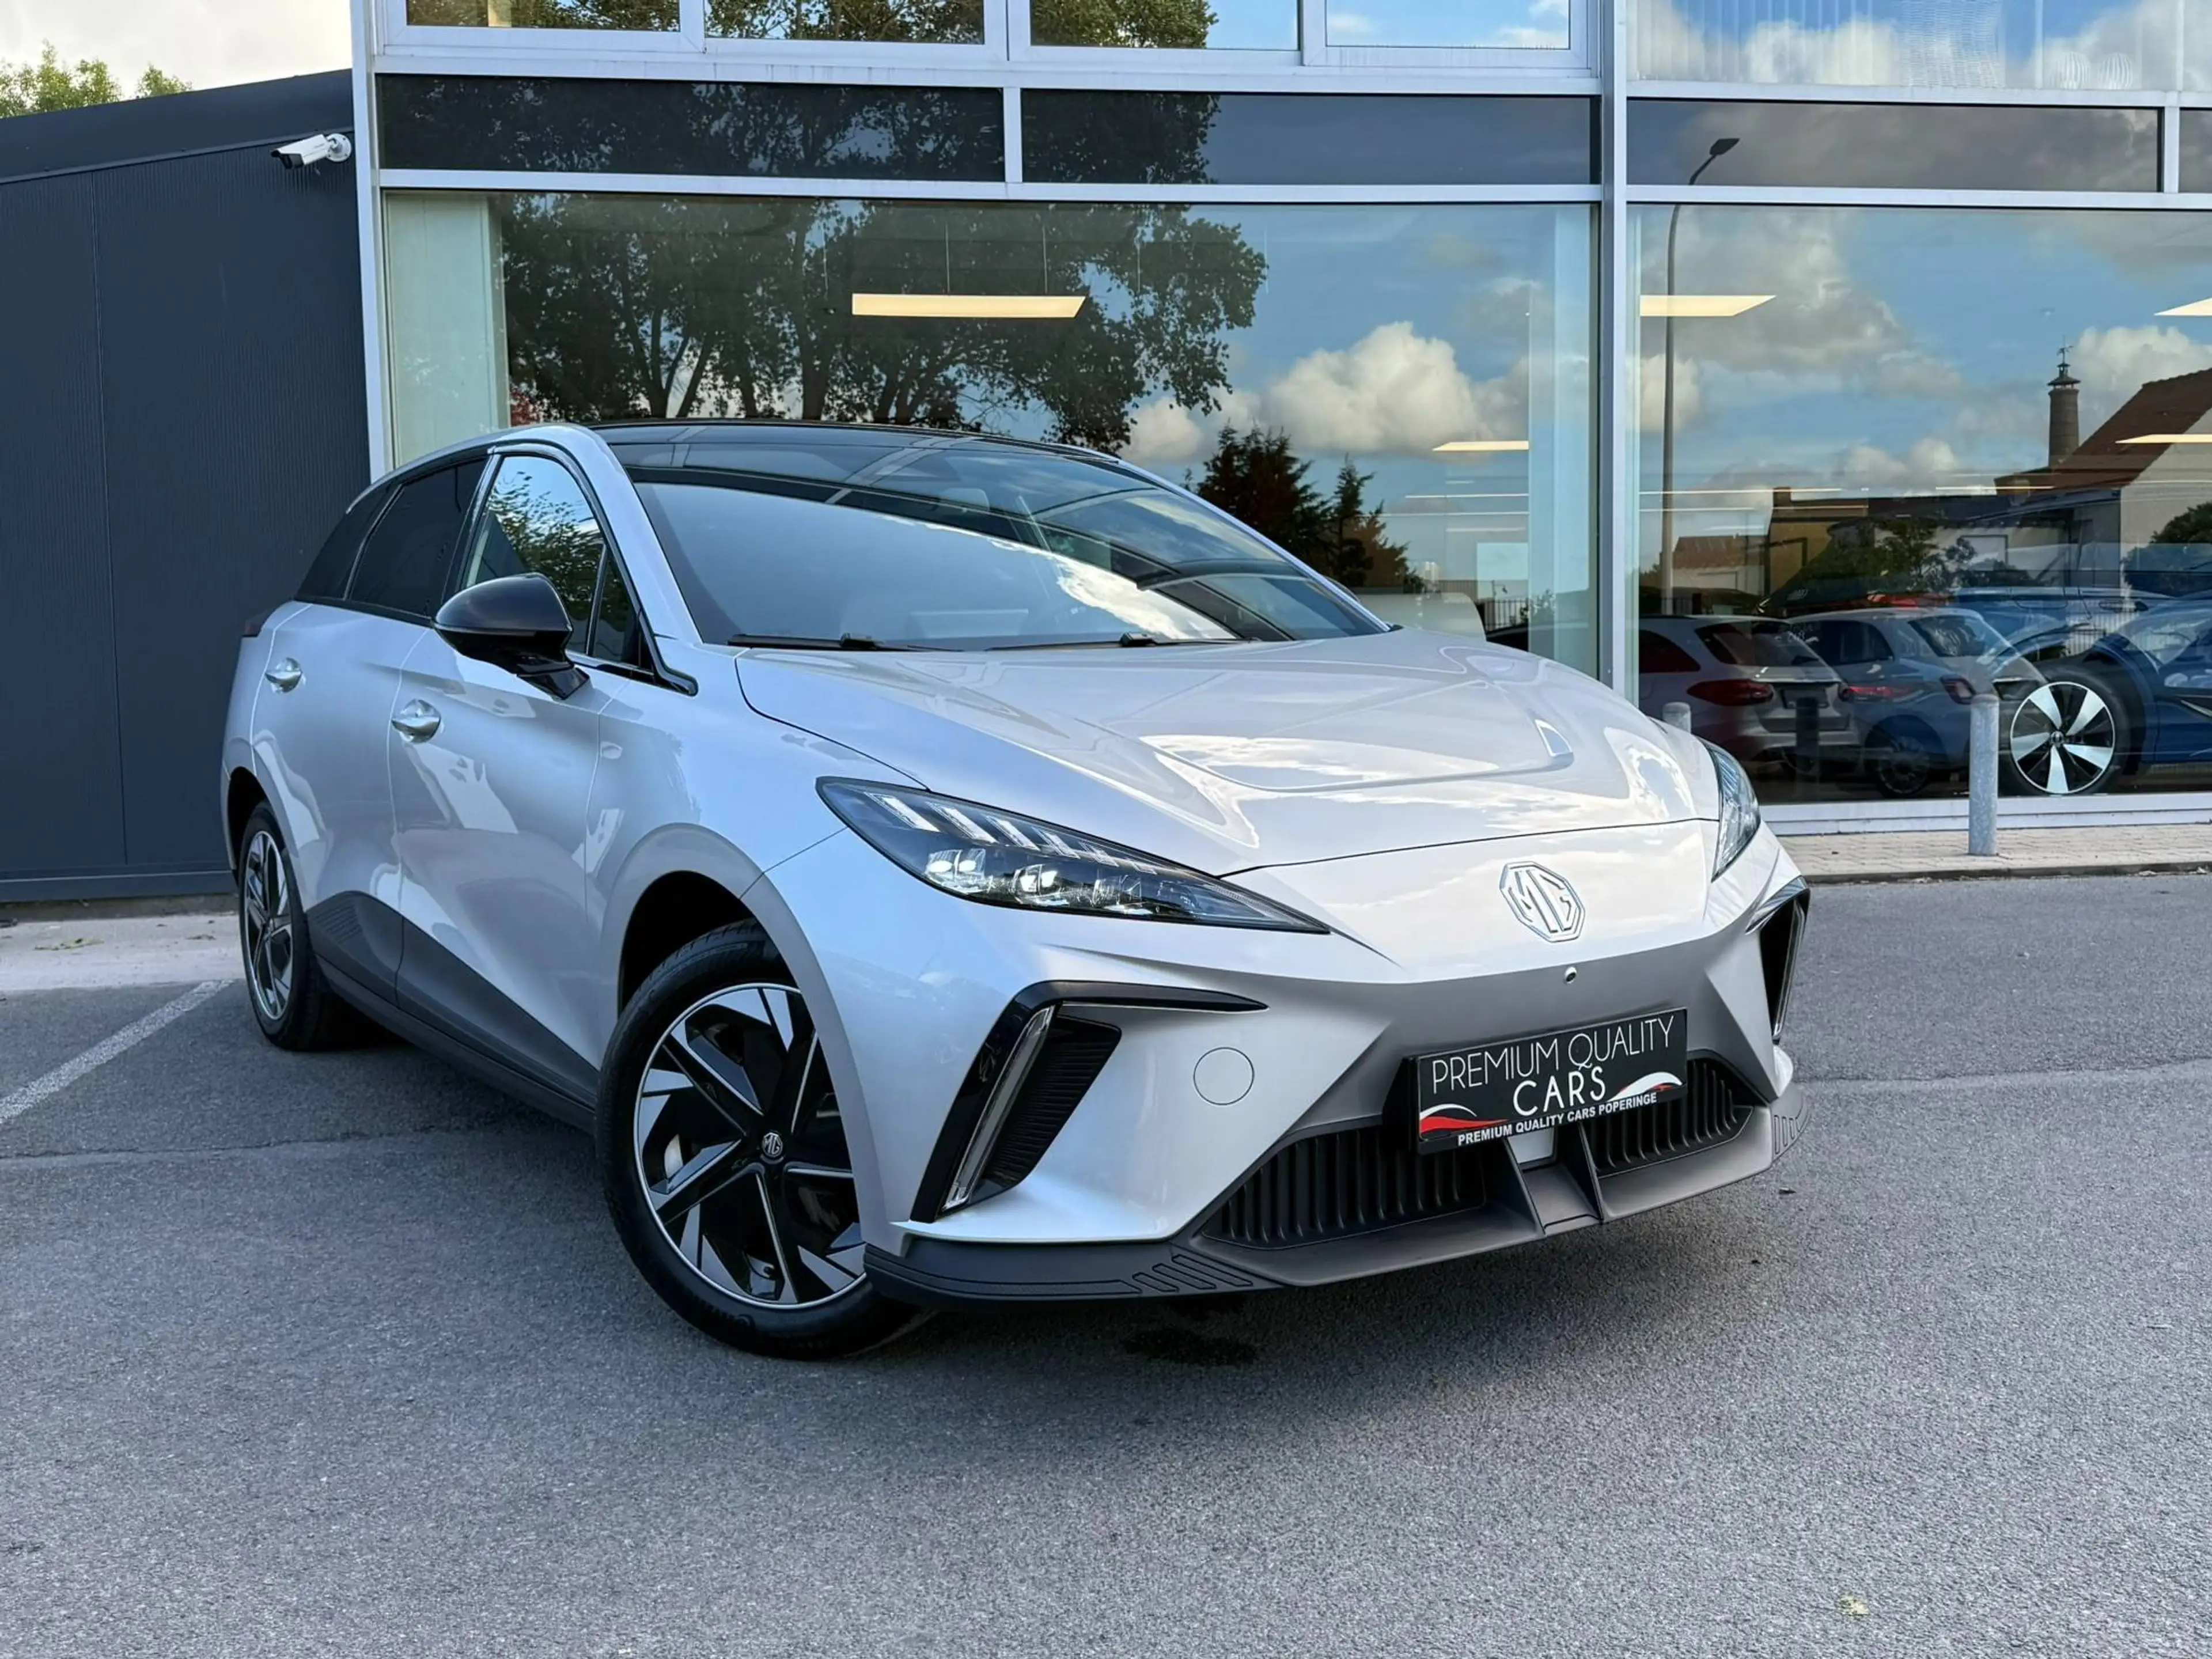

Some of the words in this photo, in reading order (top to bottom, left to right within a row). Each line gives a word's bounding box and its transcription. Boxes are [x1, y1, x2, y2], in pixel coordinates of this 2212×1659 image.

[1505, 867, 1580, 934] MG
[1433, 1038, 1560, 1094] PREMIUM
[1568, 1016, 1674, 1070] QUALITY
[1513, 1066, 1607, 1116] CARS
[763, 1133, 782, 1156] MG
[1458, 1124, 1513, 1146] PREMIUM
[1516, 1113, 1564, 1133] QUALITY
[1567, 1105, 1596, 1123] CARS
[1599, 1092, 1657, 1114] POPERINGE
